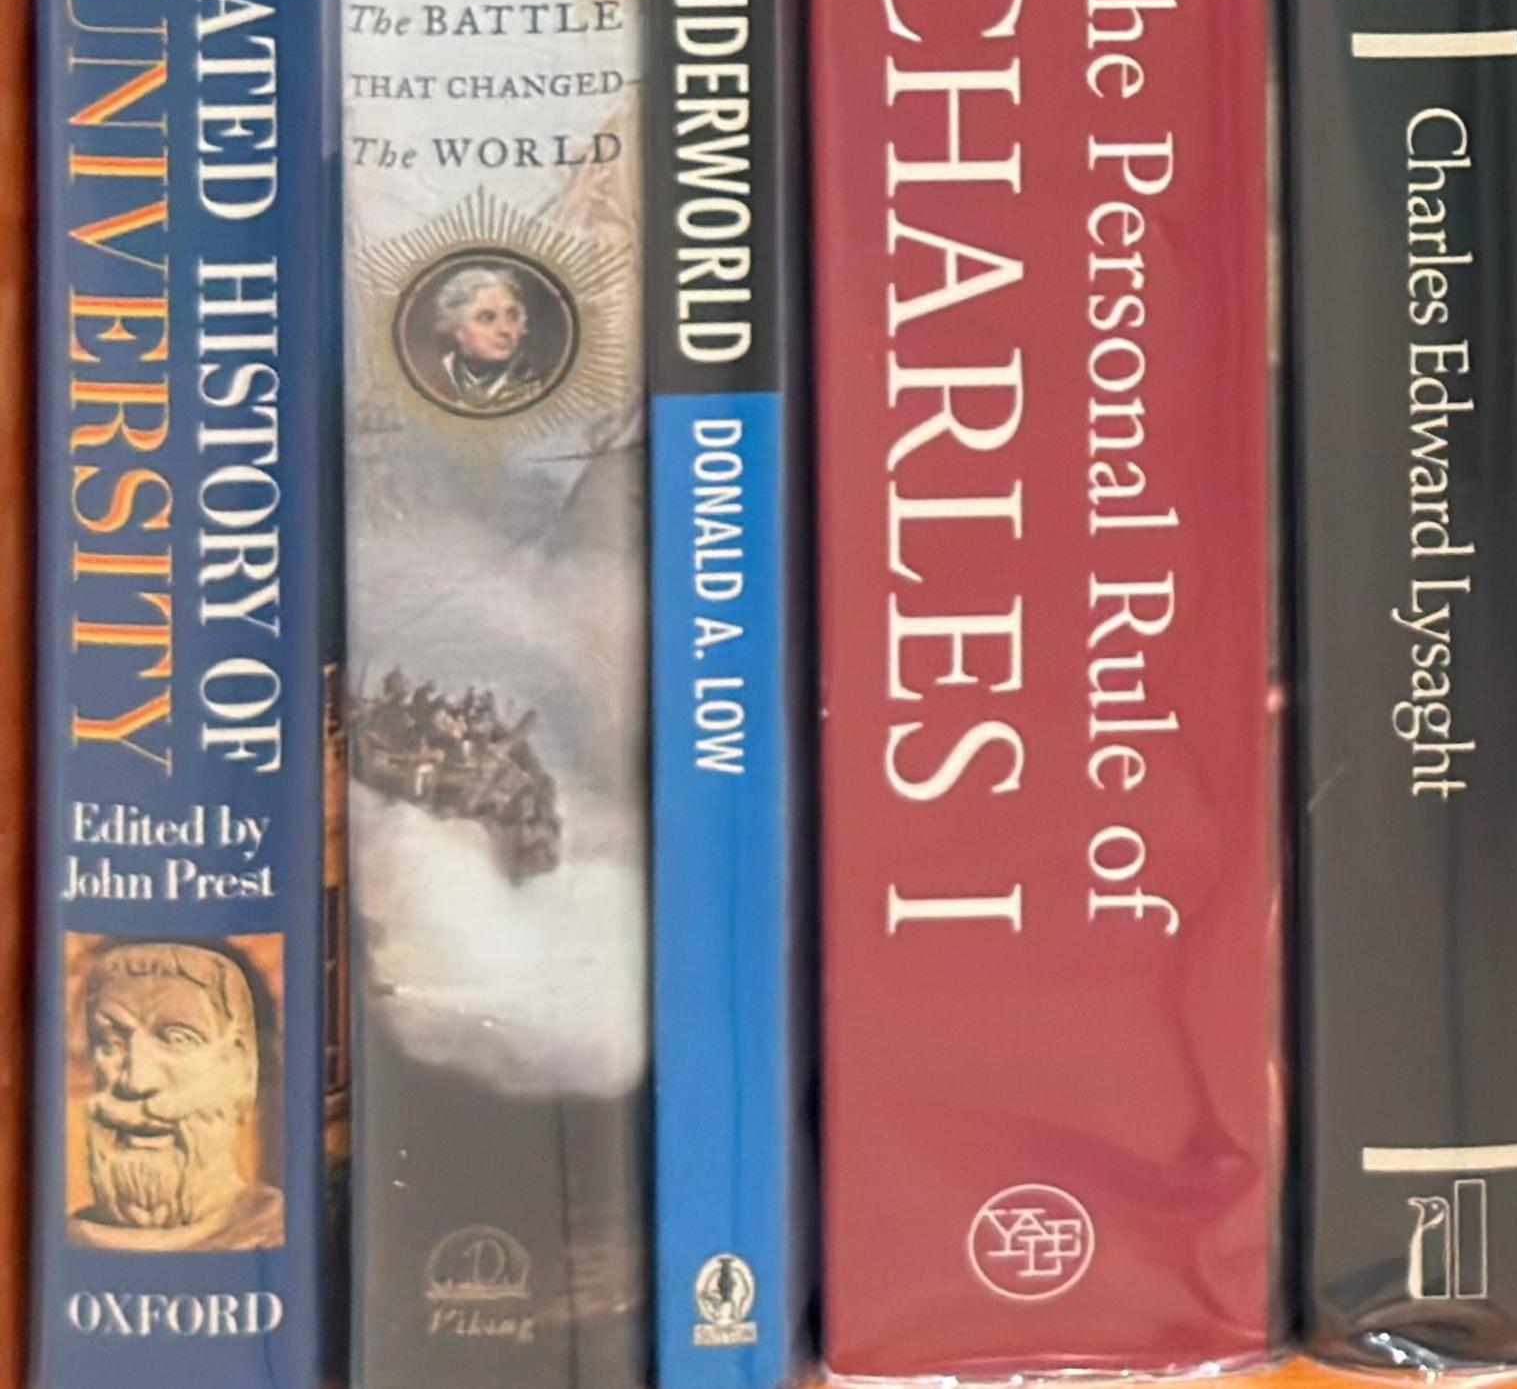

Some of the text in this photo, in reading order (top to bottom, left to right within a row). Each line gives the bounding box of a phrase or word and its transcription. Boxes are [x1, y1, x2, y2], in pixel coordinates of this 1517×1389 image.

[350, 0, 621, 39] The BATTLE
[351, 71, 623, 101] THAT CHANGED
[351, 134, 622, 170] The WORLD
[1086, 133, 1178, 536] Personal
[197, 256, 281, 651] HISTORY
[1390, 107, 1476, 799] Charles Edward Lysaght
[691, 419, 743, 774] DONALD A. LOW
[200, 659, 282, 773] OF
[1088, 573, 1178, 791] Rule
[72, 802, 269, 858] Edited by
[62, 858, 275, 900] John Prest
[889, 885, 1022, 935] I
[1088, 826, 1180, 936] of
[67, 1292, 283, 1338] OXFORD
